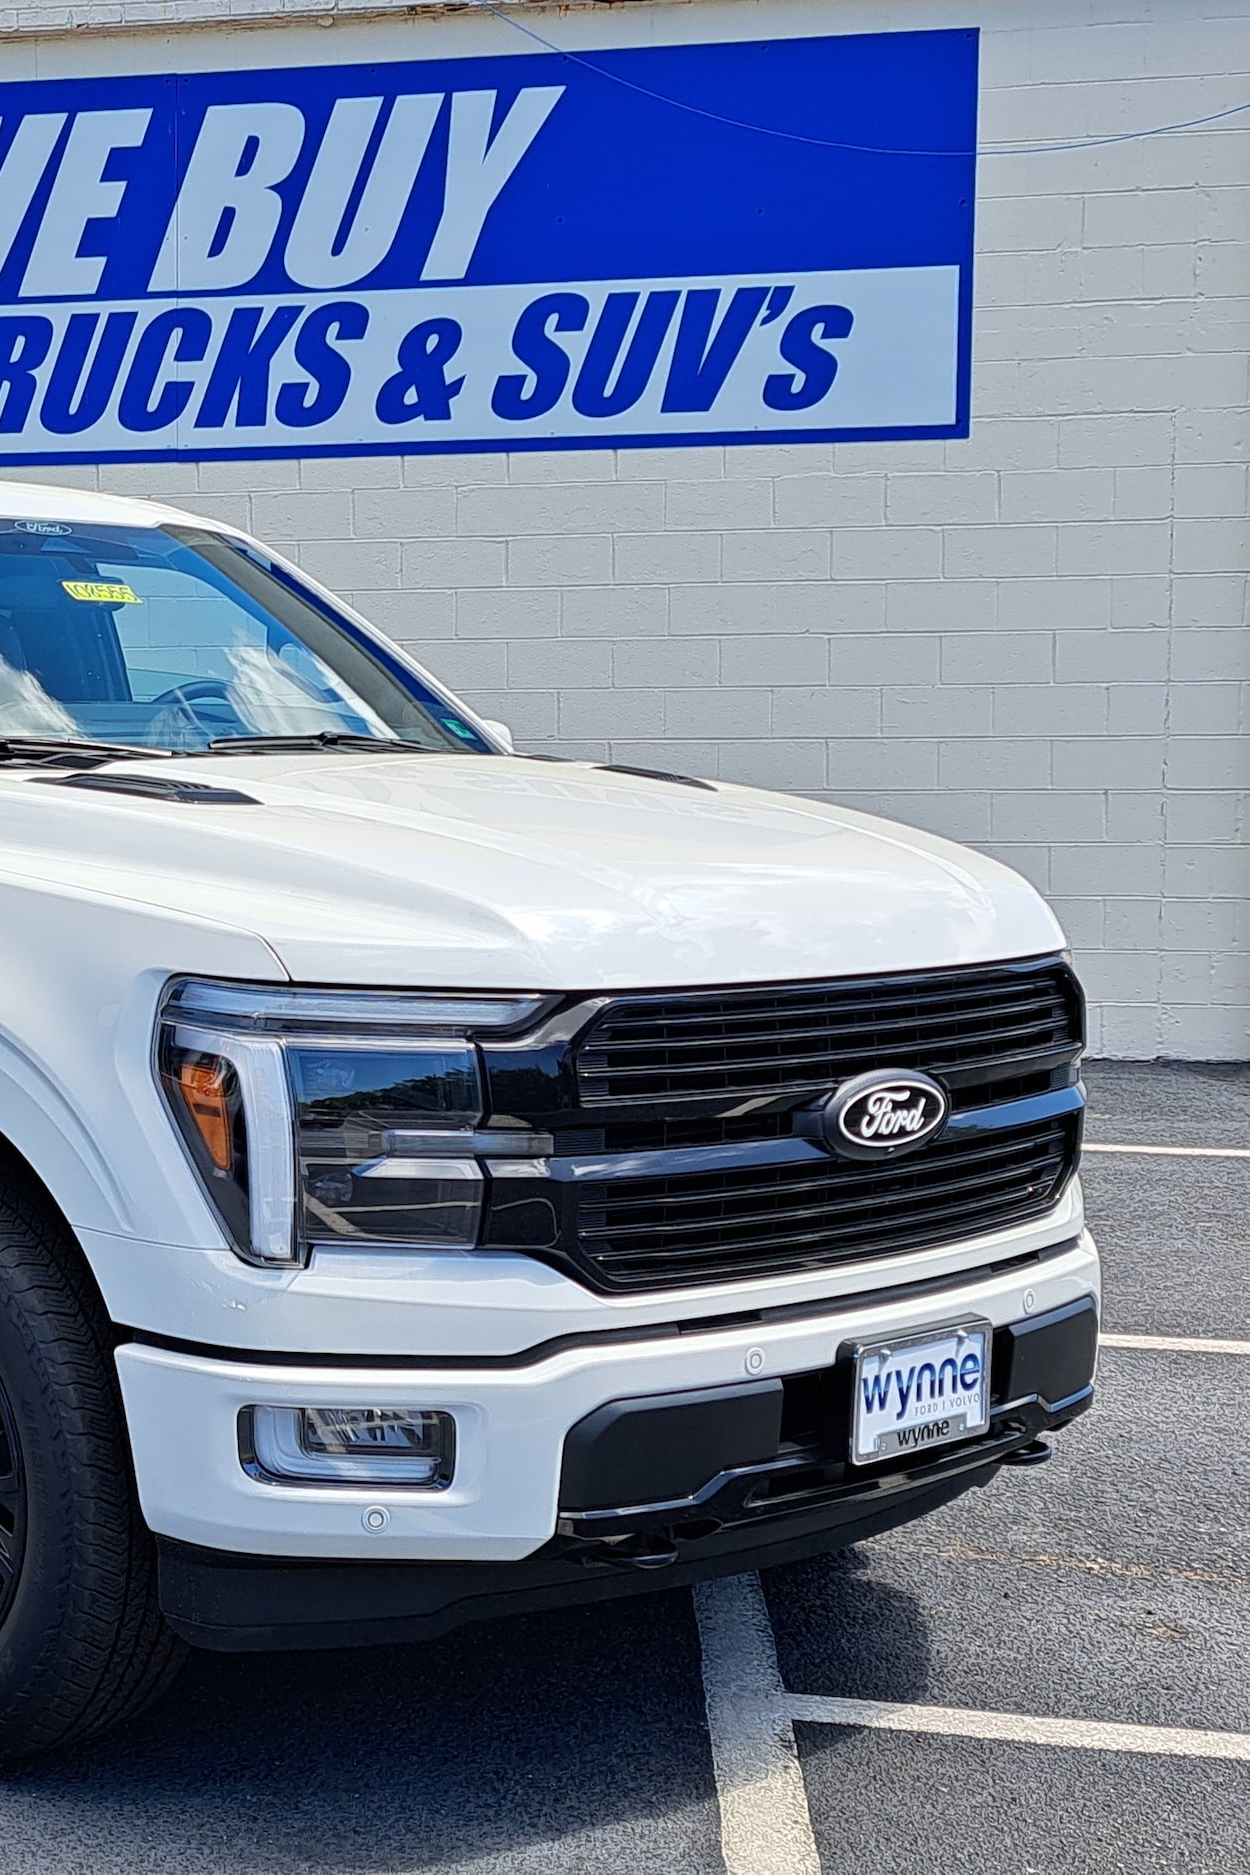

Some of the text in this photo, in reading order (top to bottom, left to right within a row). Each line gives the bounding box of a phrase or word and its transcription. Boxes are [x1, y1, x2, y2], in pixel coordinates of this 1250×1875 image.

[147, 86, 566, 292] BUY
[376, 318, 466, 424] &
[491, 286, 854, 421] SUV's
[861, 1090, 926, 1138] Ford
[862, 1353, 980, 1420] wynne
[915, 1403, 938, 1416] FORD
[949, 1393, 980, 1408] VOLVO
[898, 1420, 950, 1447] wynne
